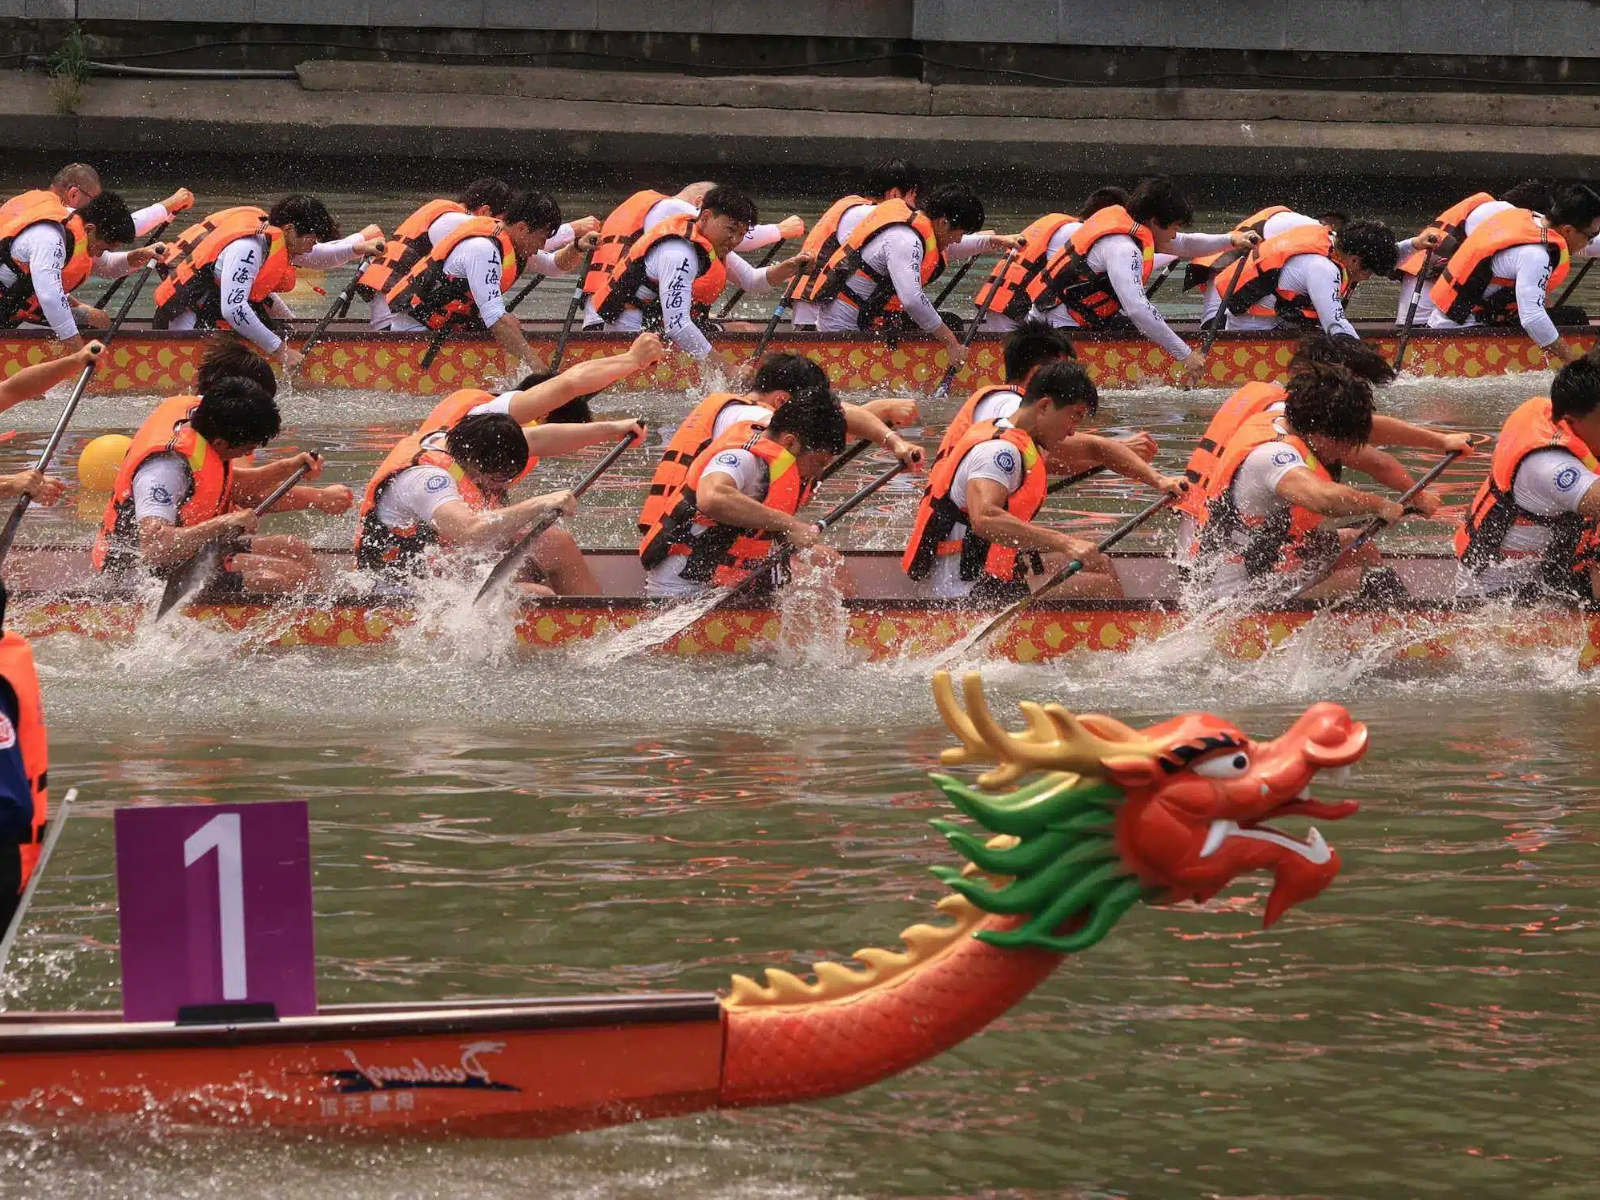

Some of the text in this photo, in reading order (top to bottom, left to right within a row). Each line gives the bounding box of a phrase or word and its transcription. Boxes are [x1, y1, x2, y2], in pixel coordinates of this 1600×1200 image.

[227, 249, 255, 327] 上海海洋
[665, 256, 690, 330] 上海海洋
[183, 812, 248, 1001] 1
